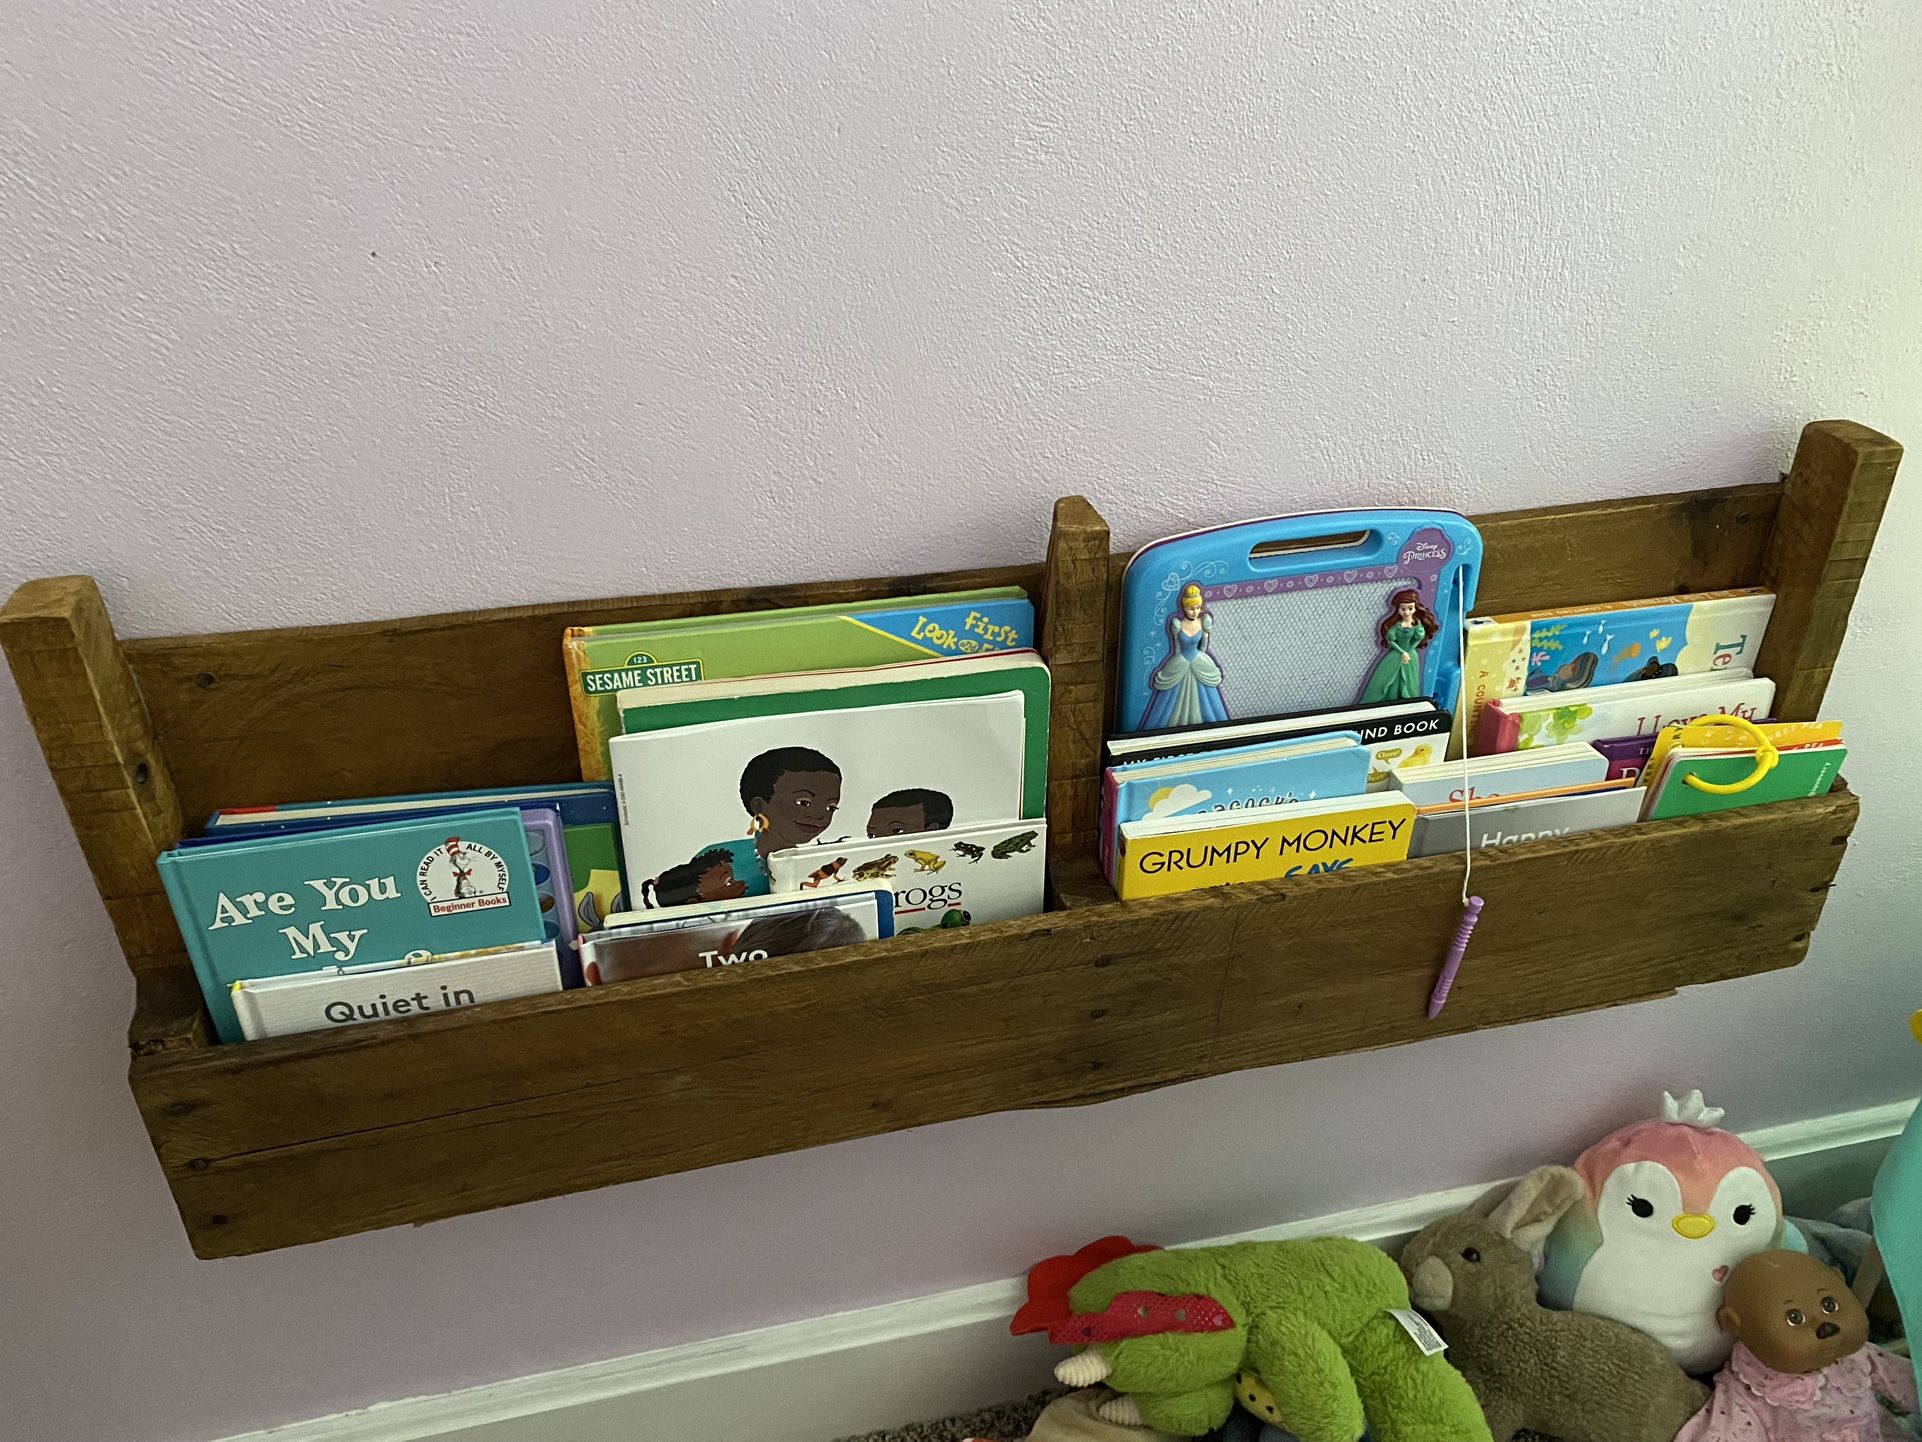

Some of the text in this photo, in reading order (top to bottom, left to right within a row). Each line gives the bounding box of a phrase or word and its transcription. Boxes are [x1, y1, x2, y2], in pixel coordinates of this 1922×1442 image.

[1402, 549, 1447, 565] PRINCESS
[911, 615, 958, 650] Look
[964, 610, 1019, 646] First
[633, 656, 647, 664] 123
[1710, 634, 1747, 671] Te
[586, 664, 697, 691] SESAME STREET
[1393, 719, 1440, 736] BOOK
[1448, 786, 1501, 803] Sh
[434, 848, 444, 857] IT
[466, 843, 483, 854] ALL
[485, 851, 498, 861] BY
[1139, 818, 1407, 874] GRUMPY MONKEY
[419, 856, 435, 877] READ
[494, 861, 507, 892] MYSELF
[420, 879, 432, 896] CAN
[893, 882, 962, 910] rogs
[207, 874, 402, 931] Are You
[433, 897, 508, 913] Beginner Books
[278, 920, 369, 961] My
[698, 949, 769, 968] Two
[324, 985, 475, 1024] Quiet in
